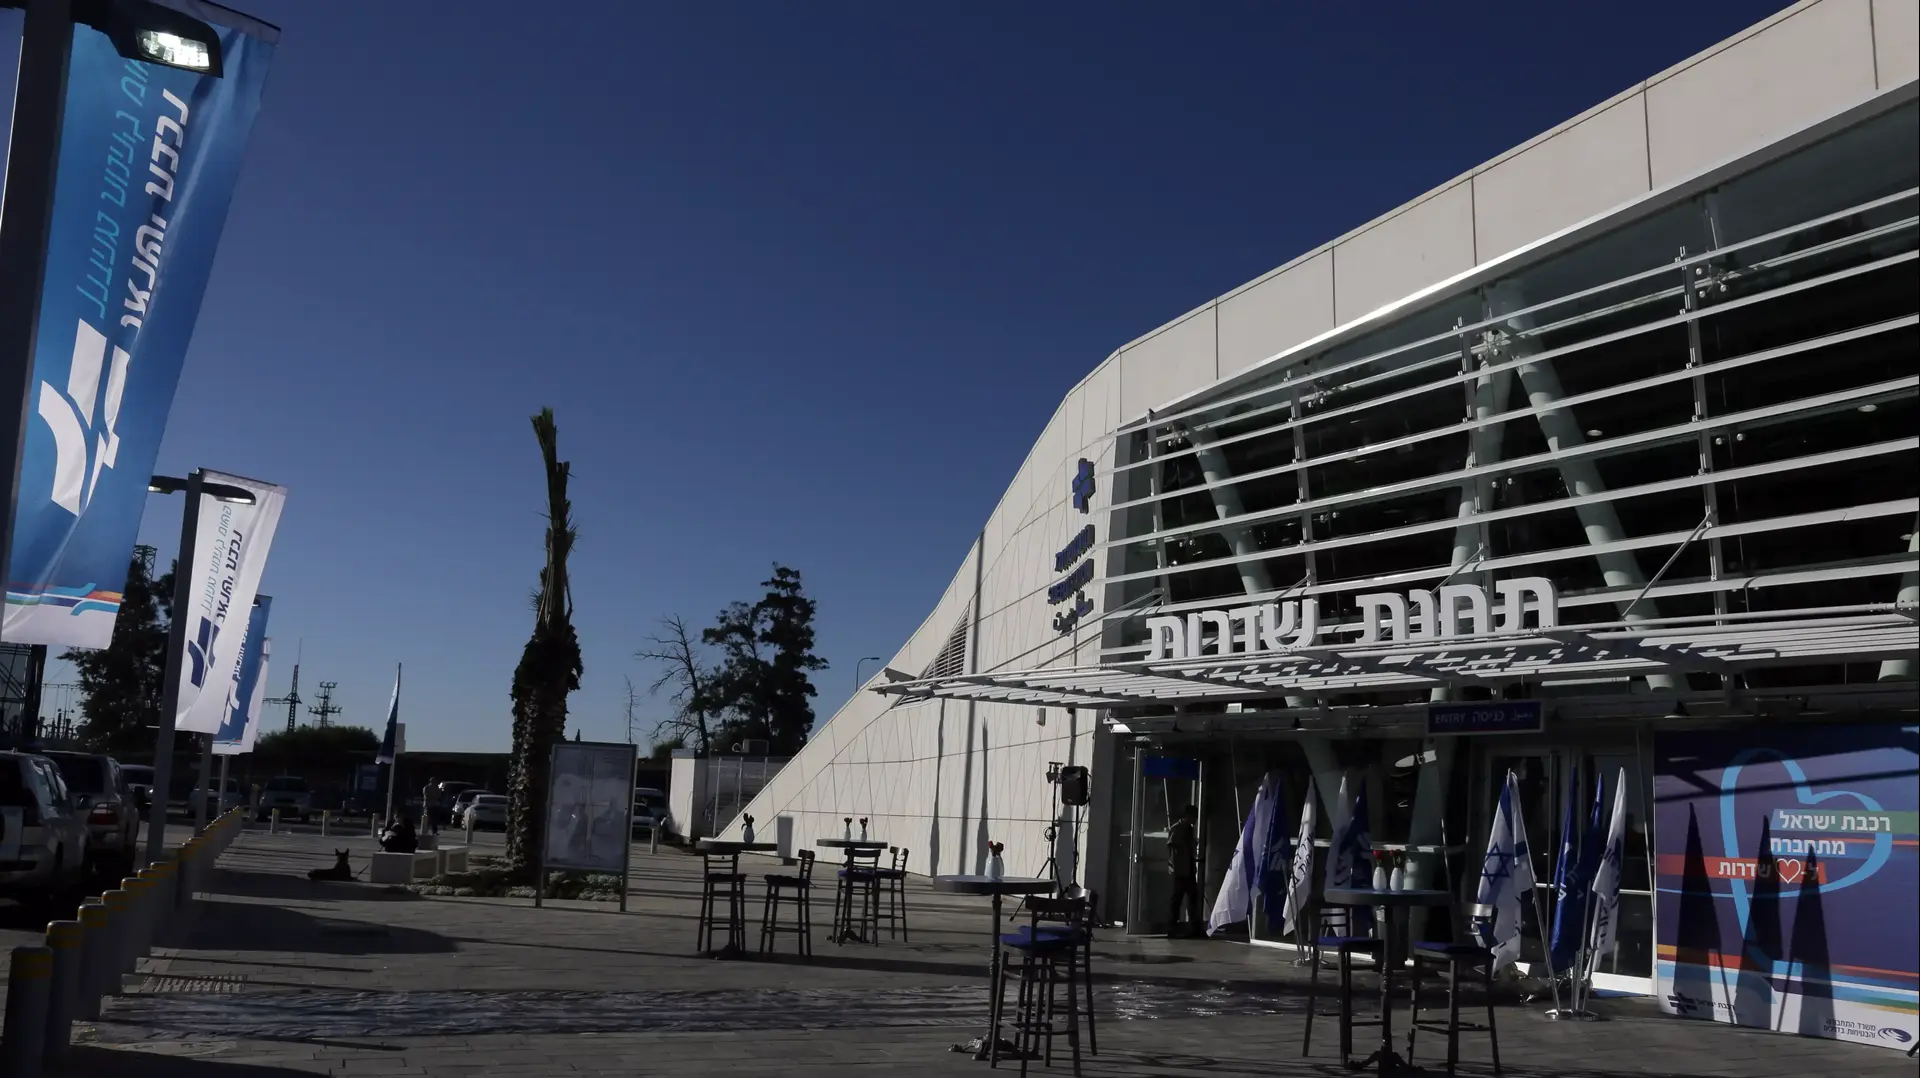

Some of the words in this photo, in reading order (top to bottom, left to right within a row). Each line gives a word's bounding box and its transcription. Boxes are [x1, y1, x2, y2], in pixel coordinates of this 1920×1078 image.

[1354, 576, 1559, 645] תחנת
[1143, 598, 1319, 661] שדרות
[1434, 711, 1467, 725] ENTRY
[1471, 709, 1505, 723] כניסה
[1779, 810, 1836, 830] ישראל
[1840, 815, 1891, 832] רכבת
[1769, 837, 1846, 855] מתחברת
[1718, 861, 1772, 878] שדרות
[1857, 1022, 1877, 1032] משרד
